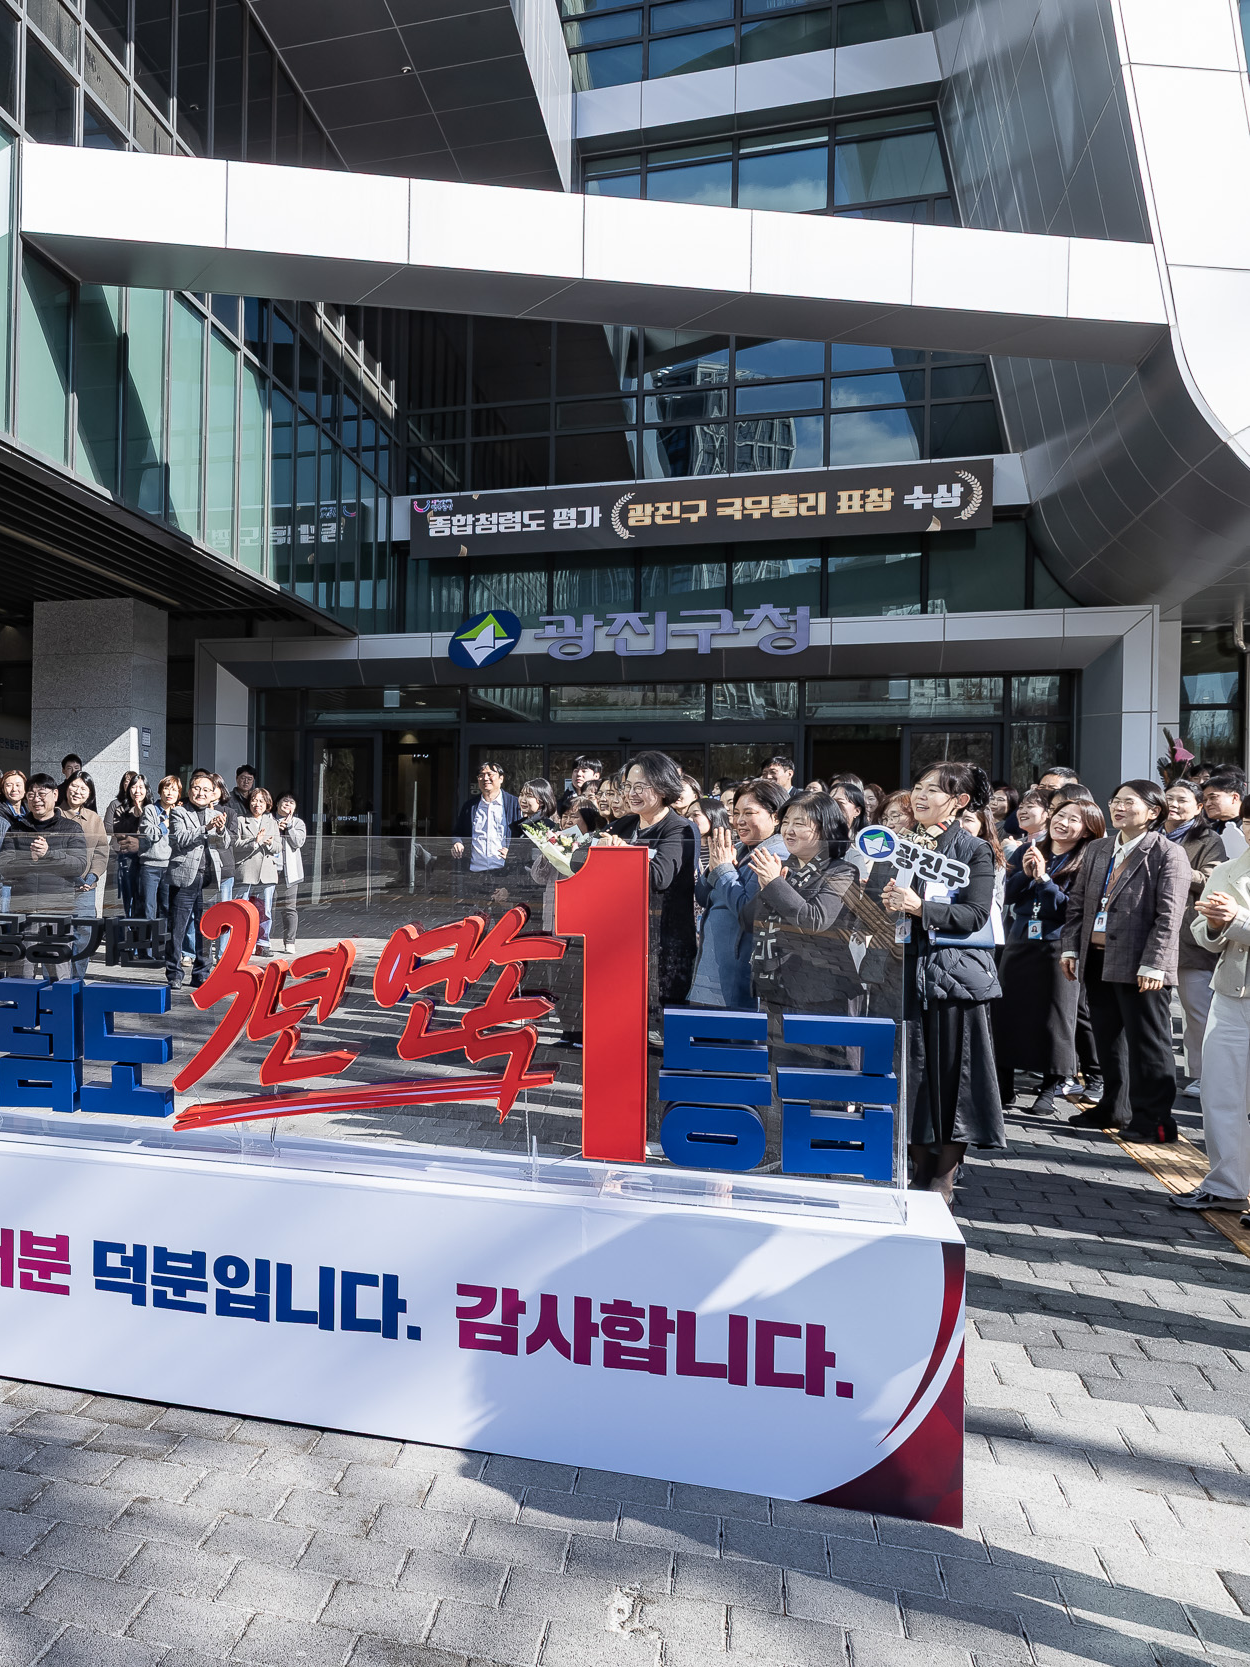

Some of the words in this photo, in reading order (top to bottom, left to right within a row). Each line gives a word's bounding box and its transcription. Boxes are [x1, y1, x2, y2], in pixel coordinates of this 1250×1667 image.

[428, 509, 546, 537] 종합청렴도
[552, 506, 602, 530] 평가
[627, 499, 708, 527] 광진구
[716, 491, 828, 521] 국무총리
[835, 487, 895, 515] 표창
[903, 482, 964, 510] 수상
[533, 603, 811, 661] 광진구청
[895, 842, 966, 888] 광진구
[171, 897, 360, 1094] 3년
[372, 902, 567, 1124] 연속
[92, 1239, 422, 1342] 덕분입니다.
[455, 1282, 855, 1399] 감사합니다.
